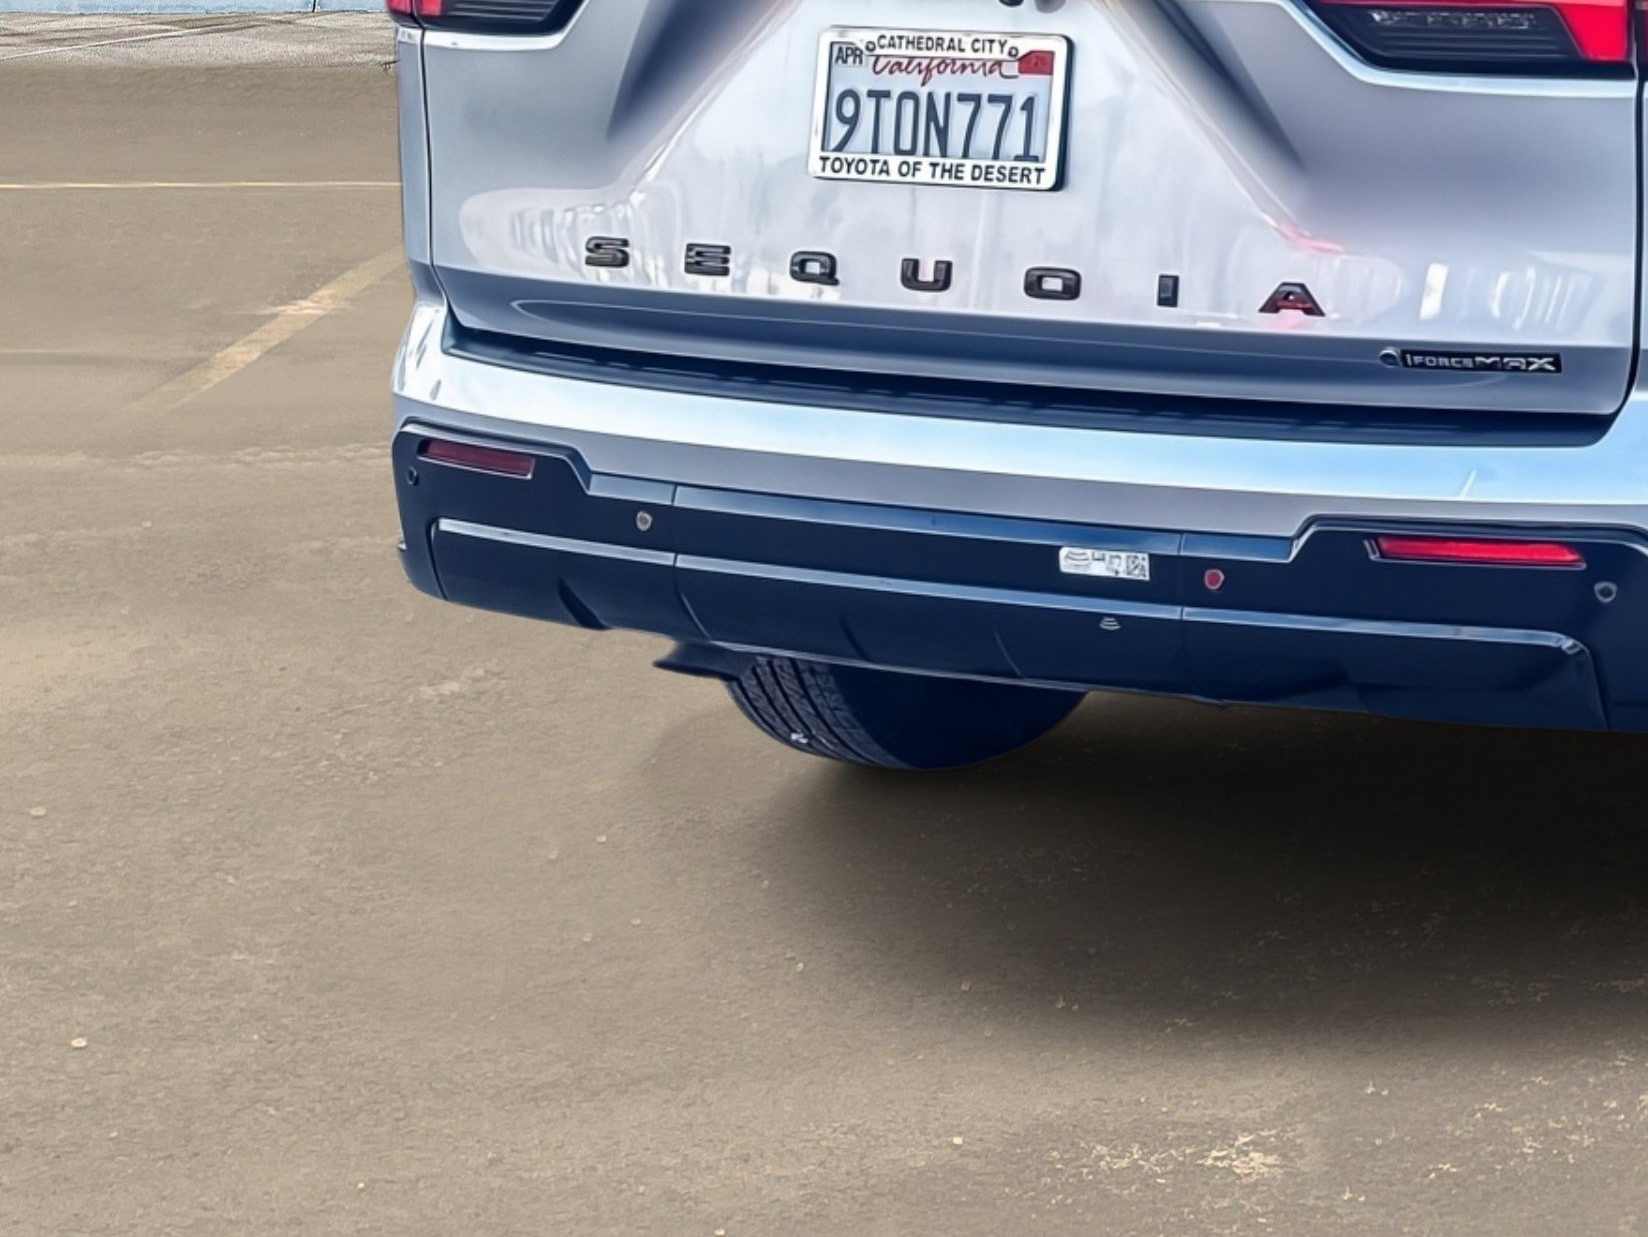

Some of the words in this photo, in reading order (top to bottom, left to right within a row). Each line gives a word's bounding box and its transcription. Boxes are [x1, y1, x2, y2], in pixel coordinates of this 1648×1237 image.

[834, 45, 864, 65] APR
[877, 34, 966, 53] CATHEDRAL
[971, 38, 1009, 54] CITY
[872, 55, 1019, 87] California
[828, 89, 1040, 162] 9TON771
[819, 156, 890, 177] TOYOTA
[898, 160, 923, 179] OF
[929, 162, 965, 181] THE
[970, 164, 1046, 185] DESERT
[584, 235, 1327, 318] SEQUOIA
